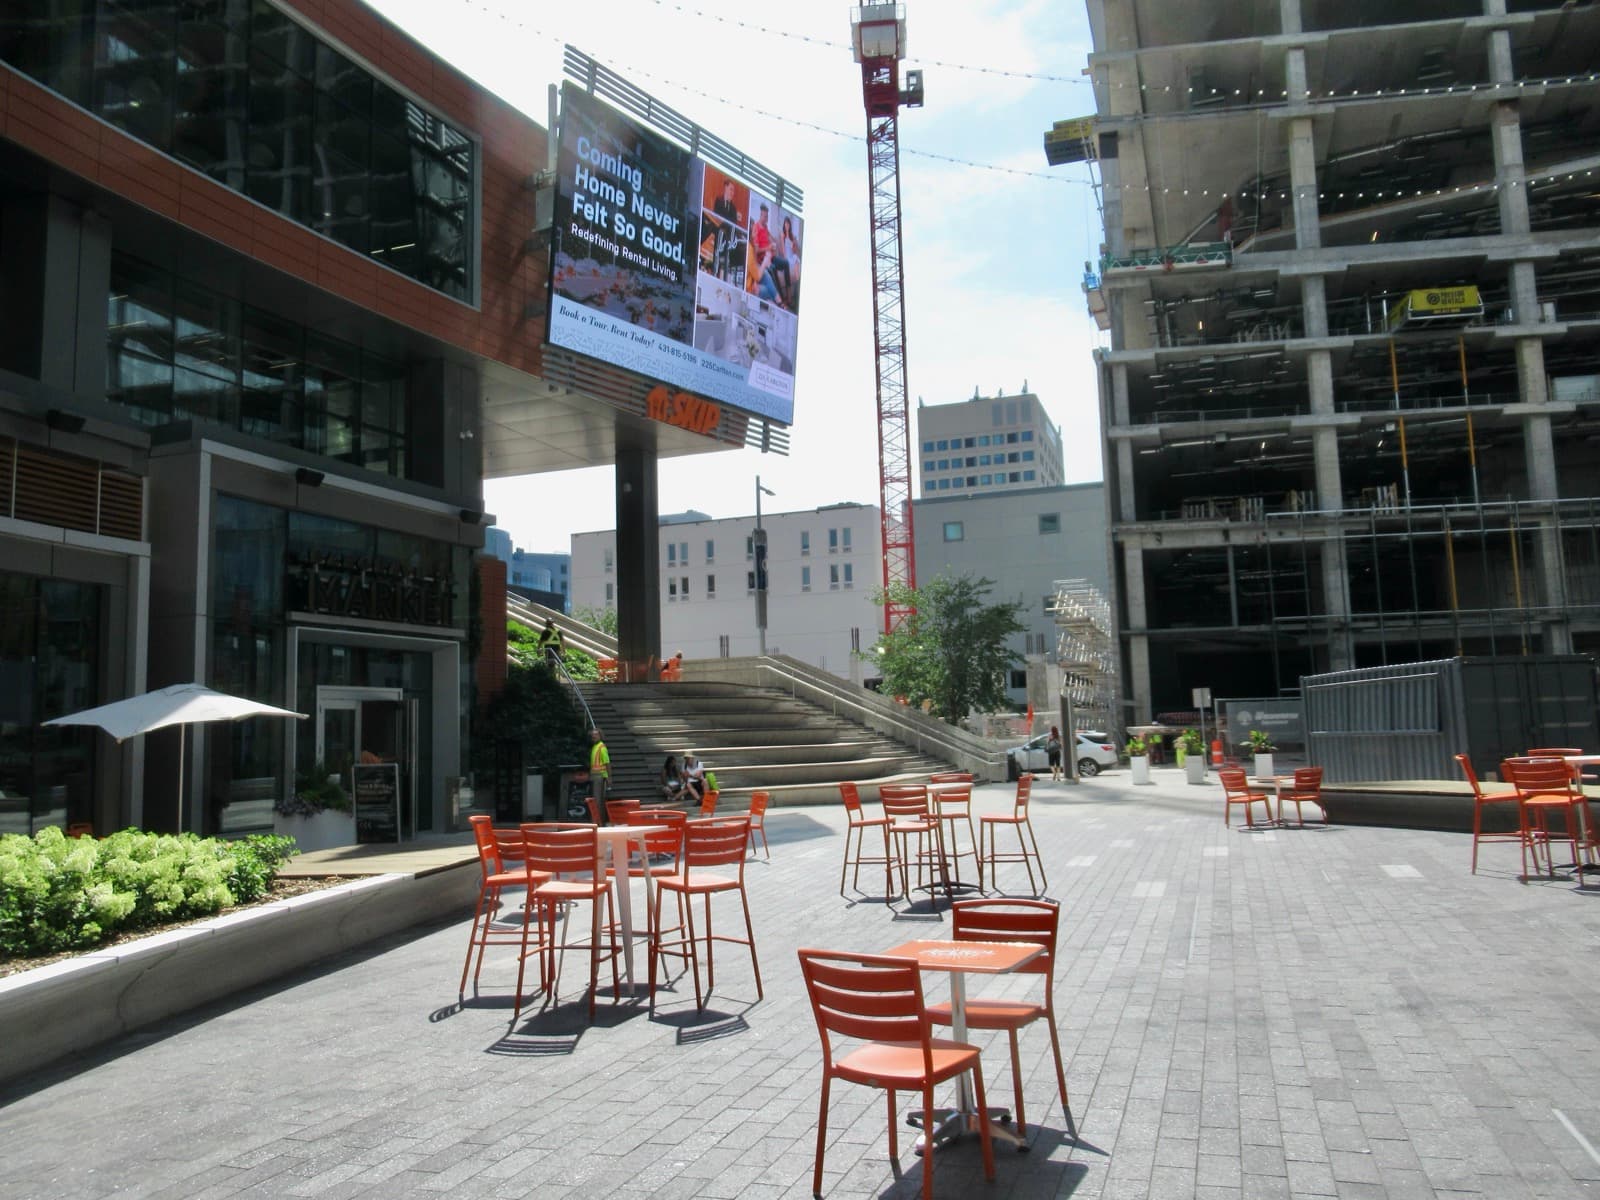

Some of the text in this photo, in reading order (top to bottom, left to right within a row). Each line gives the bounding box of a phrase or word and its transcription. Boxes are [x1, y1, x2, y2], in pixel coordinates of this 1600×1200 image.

[577, 136, 642, 192] Coming
[575, 164, 680, 234] Home Never
[571, 223, 678, 281] Redefining Rental Living.
[573, 192, 686, 265] Felt So Good.
[559, 304, 579, 321] Book
[610, 323, 629, 338] Rent
[630, 331, 655, 348] Today!
[667, 392, 721, 435] SKIP
